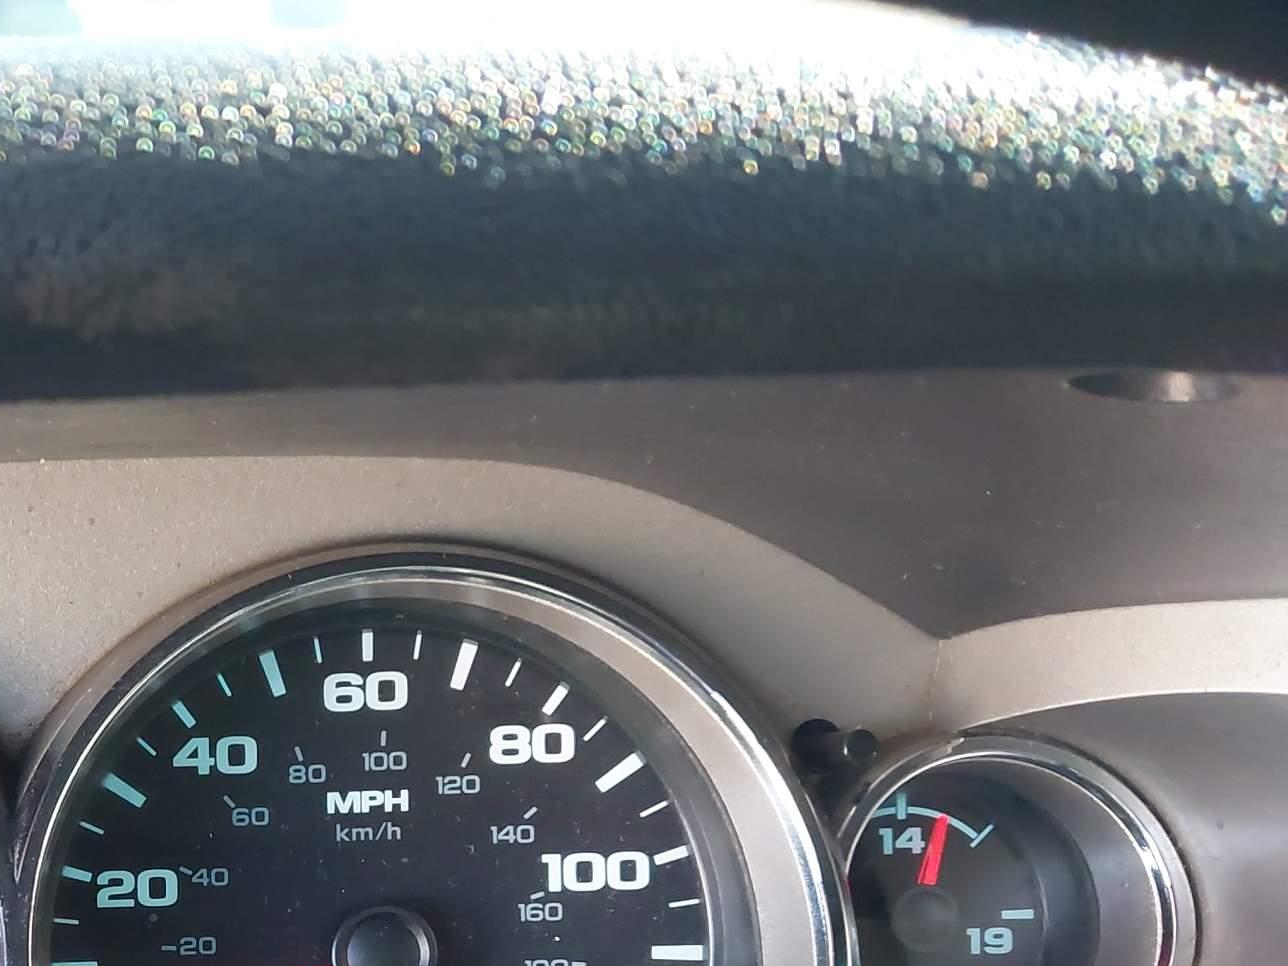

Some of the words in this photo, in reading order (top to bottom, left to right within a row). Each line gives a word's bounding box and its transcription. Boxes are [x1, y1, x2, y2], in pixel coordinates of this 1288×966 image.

[323, 672, 409, 712] 60
[489, 724, 576, 764] 80
[173, 735, 258, 775] 40
[362, 751, 408, 771] 100
[288, 764, 326, 784] 80
[436, 775, 481, 795] 120
[326, 790, 410, 812] MPH
[231, 807, 270, 826] 60
[335, 822, 401, 842] km/h
[490, 824, 534, 844] 140
[878, 827, 926, 855] 14
[191, 868, 229, 886] 40
[541, 851, 650, 891] 100
[96, 868, 180, 908] 20
[518, 902, 563, 922] 160
[180, 936, 218, 956] 20
[966, 927, 1013, 954] 19
